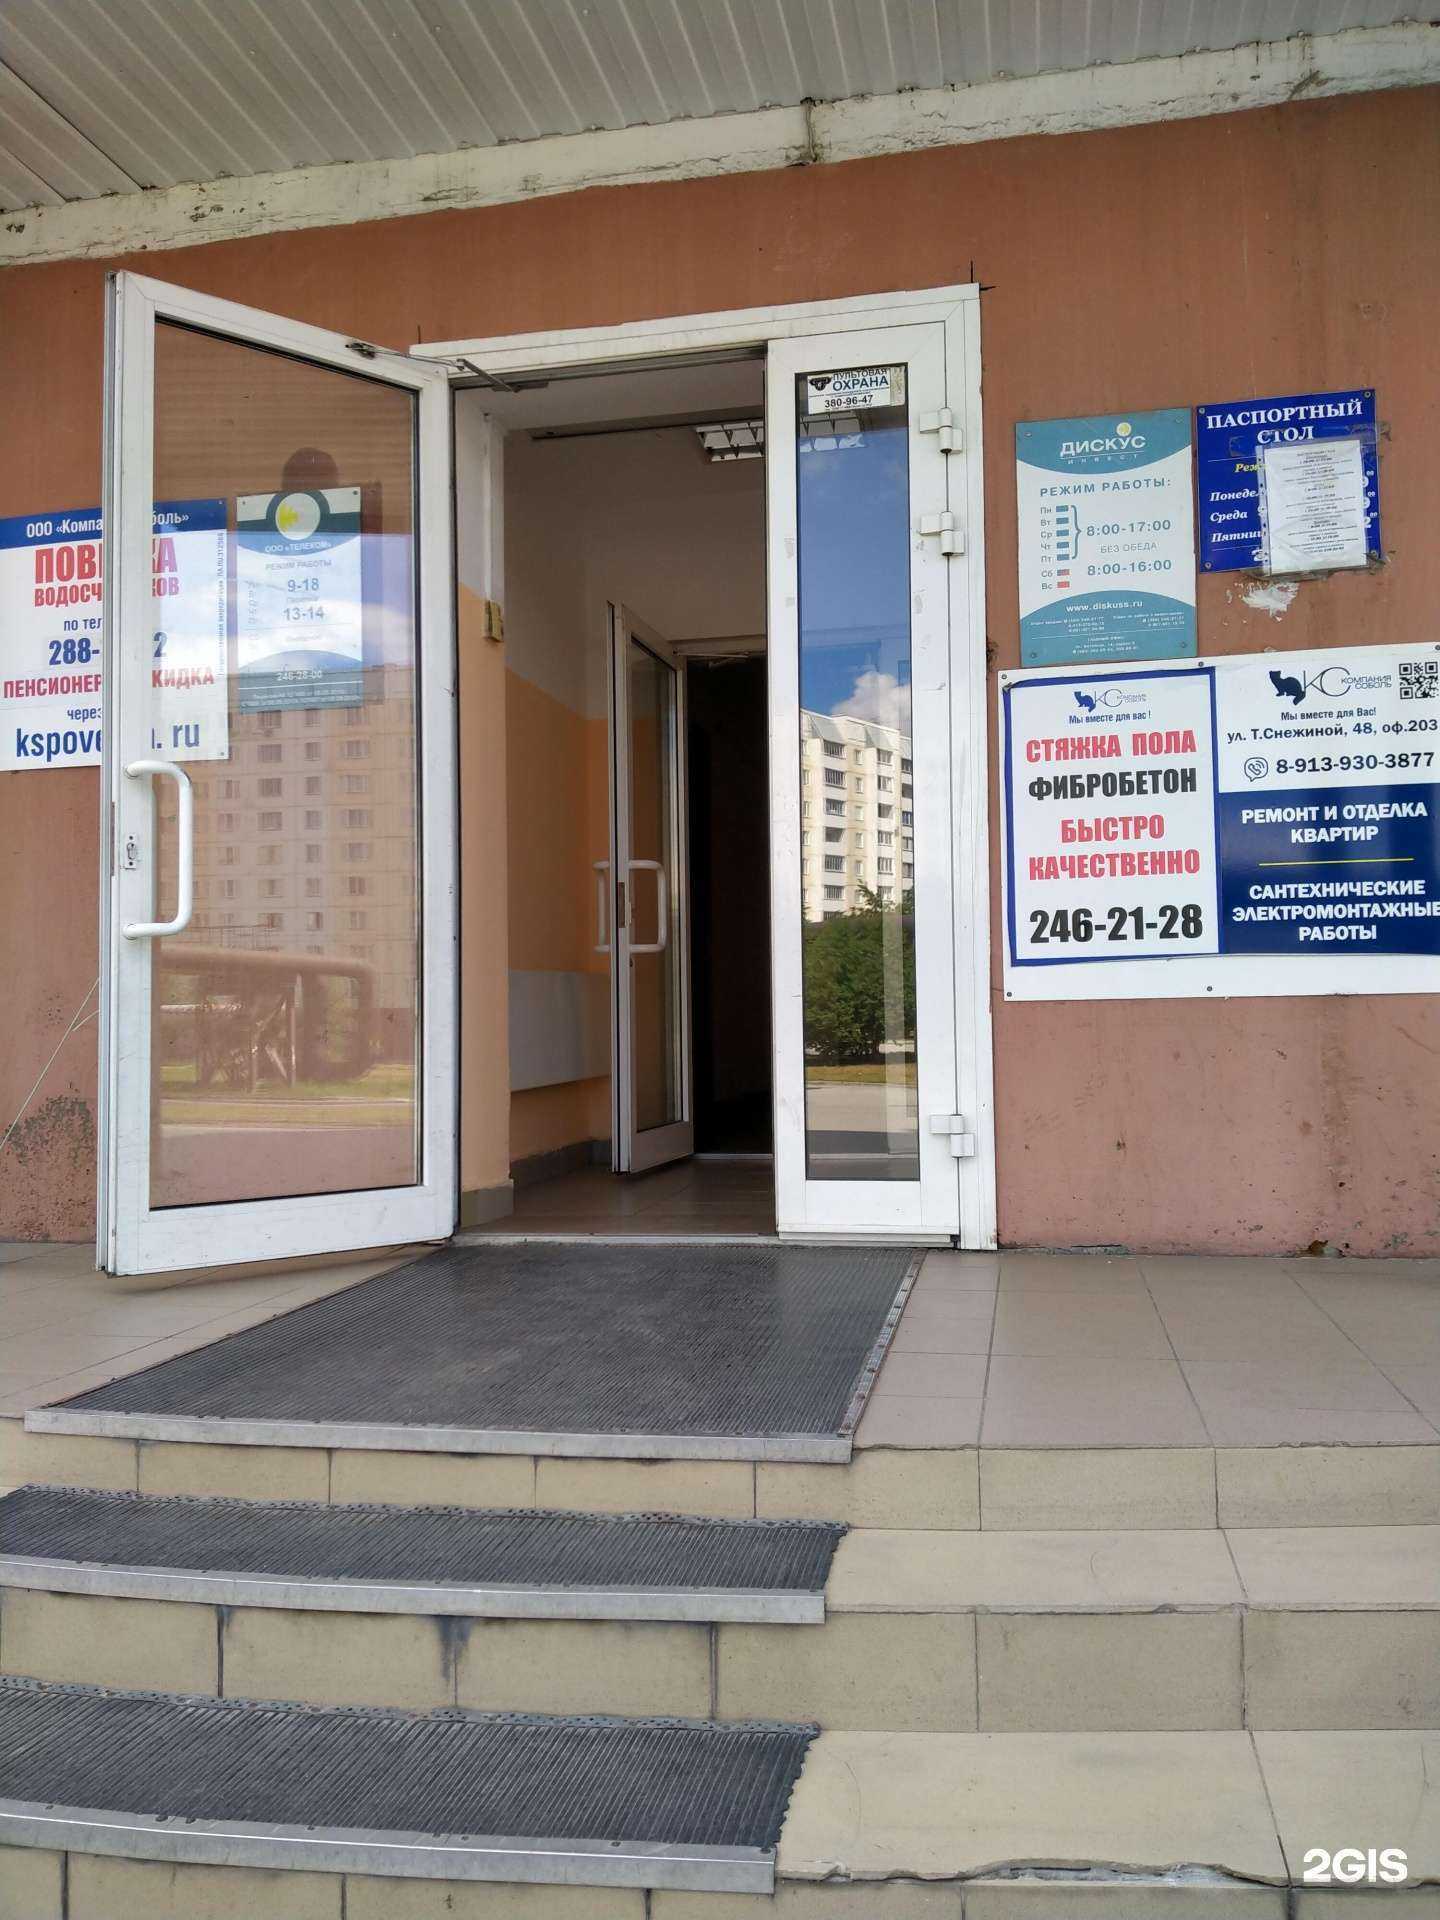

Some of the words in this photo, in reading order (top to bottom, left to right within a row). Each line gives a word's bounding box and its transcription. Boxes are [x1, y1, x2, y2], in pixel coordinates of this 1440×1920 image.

[832, 375, 889, 392] ОХРАНА
[824, 394, 874, 409] 380-96-47
[1206, 398, 1363, 429] ПАСПОРТНЫЙ
[1257, 426, 1315, 444] СТОЛ
[1060, 435, 1146, 457] ДИСКУС
[1040, 482, 1096, 497] РЕЖИМ
[1102, 477, 1172, 492] РАБОТЫ:
[1040, 507, 1052, 515] Пн
[1210, 510, 1248, 524] Среда
[26, 520, 52, 538] ООО
[1040, 519, 1051, 527] Вт
[1086, 519, 1172, 537] 8:00-17:00
[1040, 532, 1053, 541] Ср
[1040, 543, 1051, 551] Чт
[1100, 544, 1120, 553] БЕЗ
[1122, 542, 1158, 552] ОБЕДА
[296, 559, 333, 569] РАБОТЫ
[1041, 556, 1052, 564] Пт
[1087, 559, 1172, 576] 8:00-16:00
[1041, 570, 1053, 578] Сб
[287, 577, 320, 593] 9-18
[1041, 582, 1053, 590] Вс
[283, 606, 326, 621] 13-14
[1066, 600, 1143, 613] www.diskuss.ru
[64, 619, 78, 631] по
[4, 674, 102, 698] ПЕНСИОНЕР
[152, 667, 215, 690] КИДКА
[1069, 714, 1084, 724] Мы
[1085, 713, 1113, 723] вместе
[1115, 712, 1131, 722] для
[1281, 710, 1298, 721] Мы
[1300, 710, 1333, 719] вместе
[1336, 709, 1354, 719] для
[1357, 706, 1377, 716] Вас!
[1227, 731, 1246, 744] ул.
[1251, 724, 1348, 740] Т.Снежиной,
[1352, 722, 1377, 736] 48,
[1382, 719, 1438, 734] оф.203
[1026, 734, 1122, 763] СТЯЖКА
[1132, 730, 1197, 756] ПОЛА
[1276, 751, 1435, 774] 8-913-930-3877
[1028, 767, 1197, 800] ФИБРОБЕТОН
[1242, 806, 1319, 824] РЕМОНТ
[1324, 805, 1337, 820] И
[1342, 801, 1428, 821] ОТДЕЛКА
[1061, 814, 1165, 843] БЫСТРО
[1291, 825, 1379, 843] КВАРТИР
[1029, 849, 1200, 880] КАЧЕСТВЕННО
[1250, 880, 1426, 899] САНТЕХНИЧЕСКИЕ
[1232, 901, 1440, 922] ЭЛЕКТРОМОНТАЖНЫЕ
[1029, 904, 1203, 943] 246-21-28
[1299, 925, 1377, 941] РАБОТЫ
